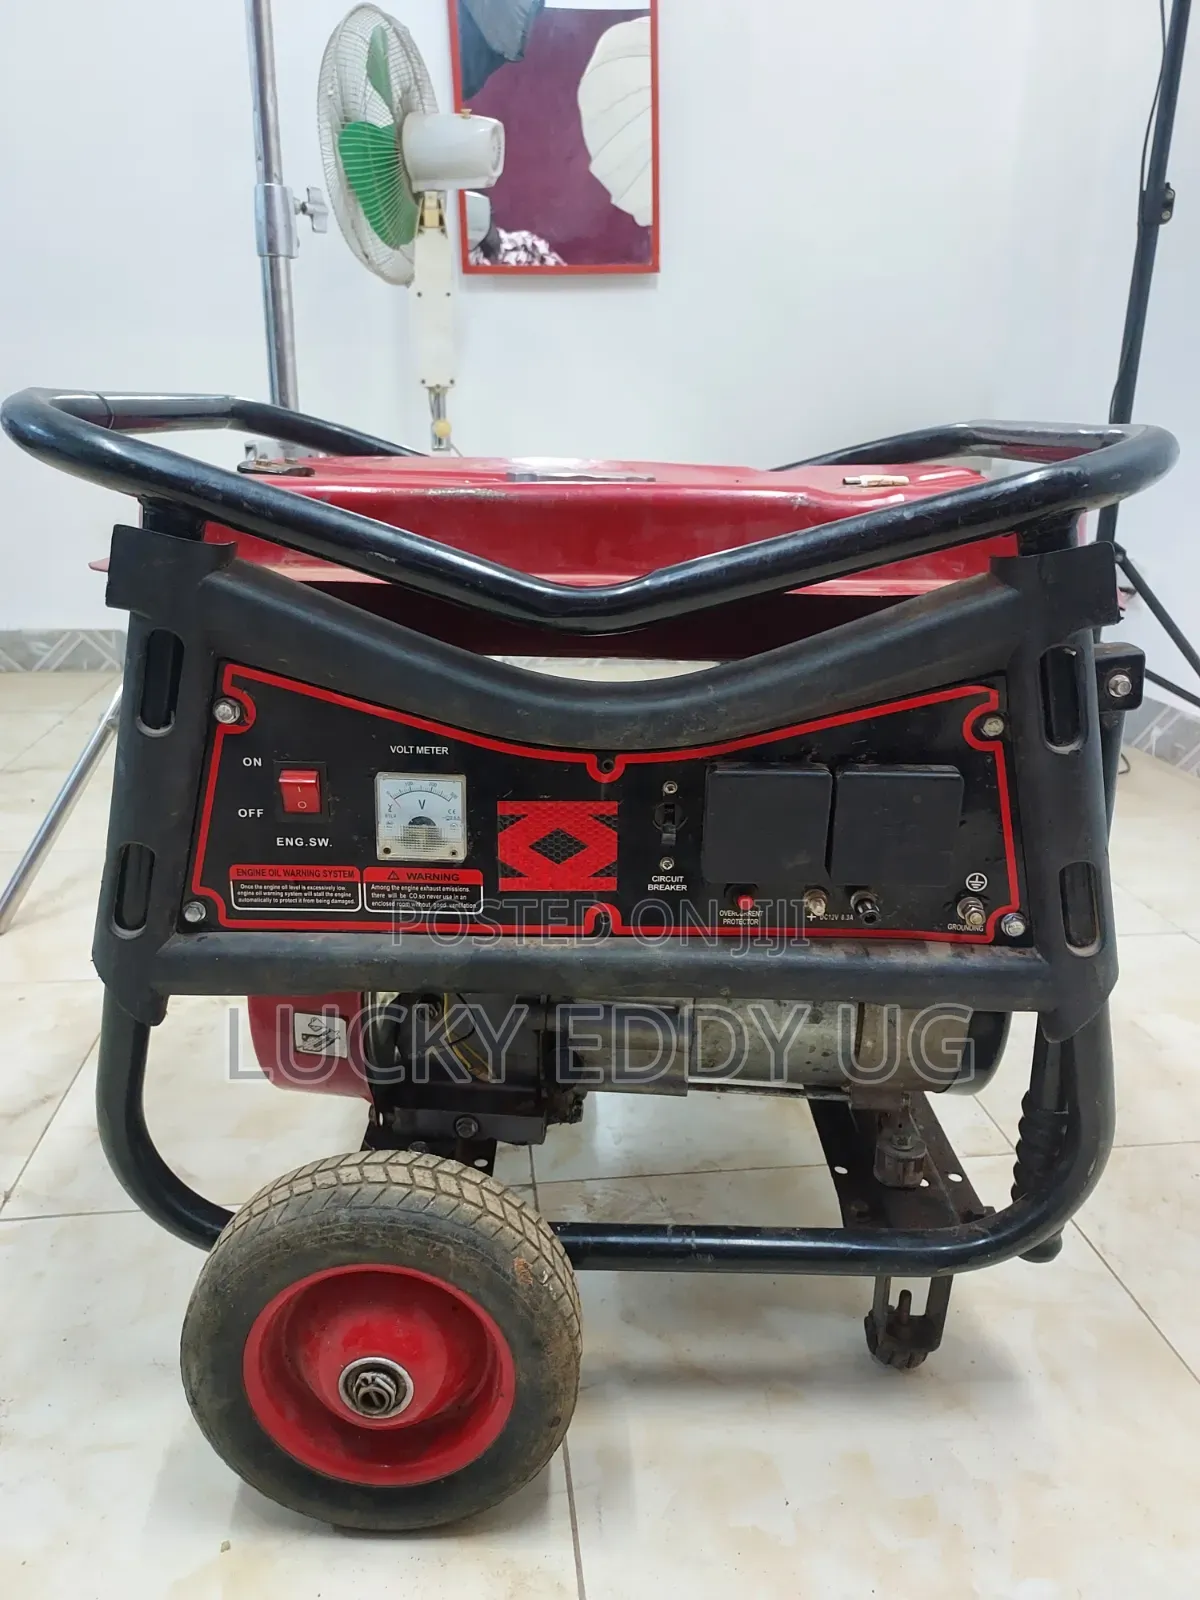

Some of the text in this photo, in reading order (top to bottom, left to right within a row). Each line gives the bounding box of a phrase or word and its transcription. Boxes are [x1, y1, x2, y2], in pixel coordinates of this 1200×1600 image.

[390, 745, 449, 755] VOLT METER
[242, 757, 262, 767] ON
[418, 799, 426, 810] V
[238, 808, 264, 818] OFF
[276, 837, 333, 847] ENG.SW.
[236, 868, 267, 877] ENGINE
[268, 868, 280, 877] OIL
[322, 869, 355, 879] SYSTEM
[406, 872, 460, 881] WARNING
[651, 875, 684, 883] CIRCUIT
[306, 884, 336, 892] excessively
[370, 884, 391, 892] Among
[647, 884, 688, 892] BREAKER
[722, 918, 759, 926] PROTECTOR
